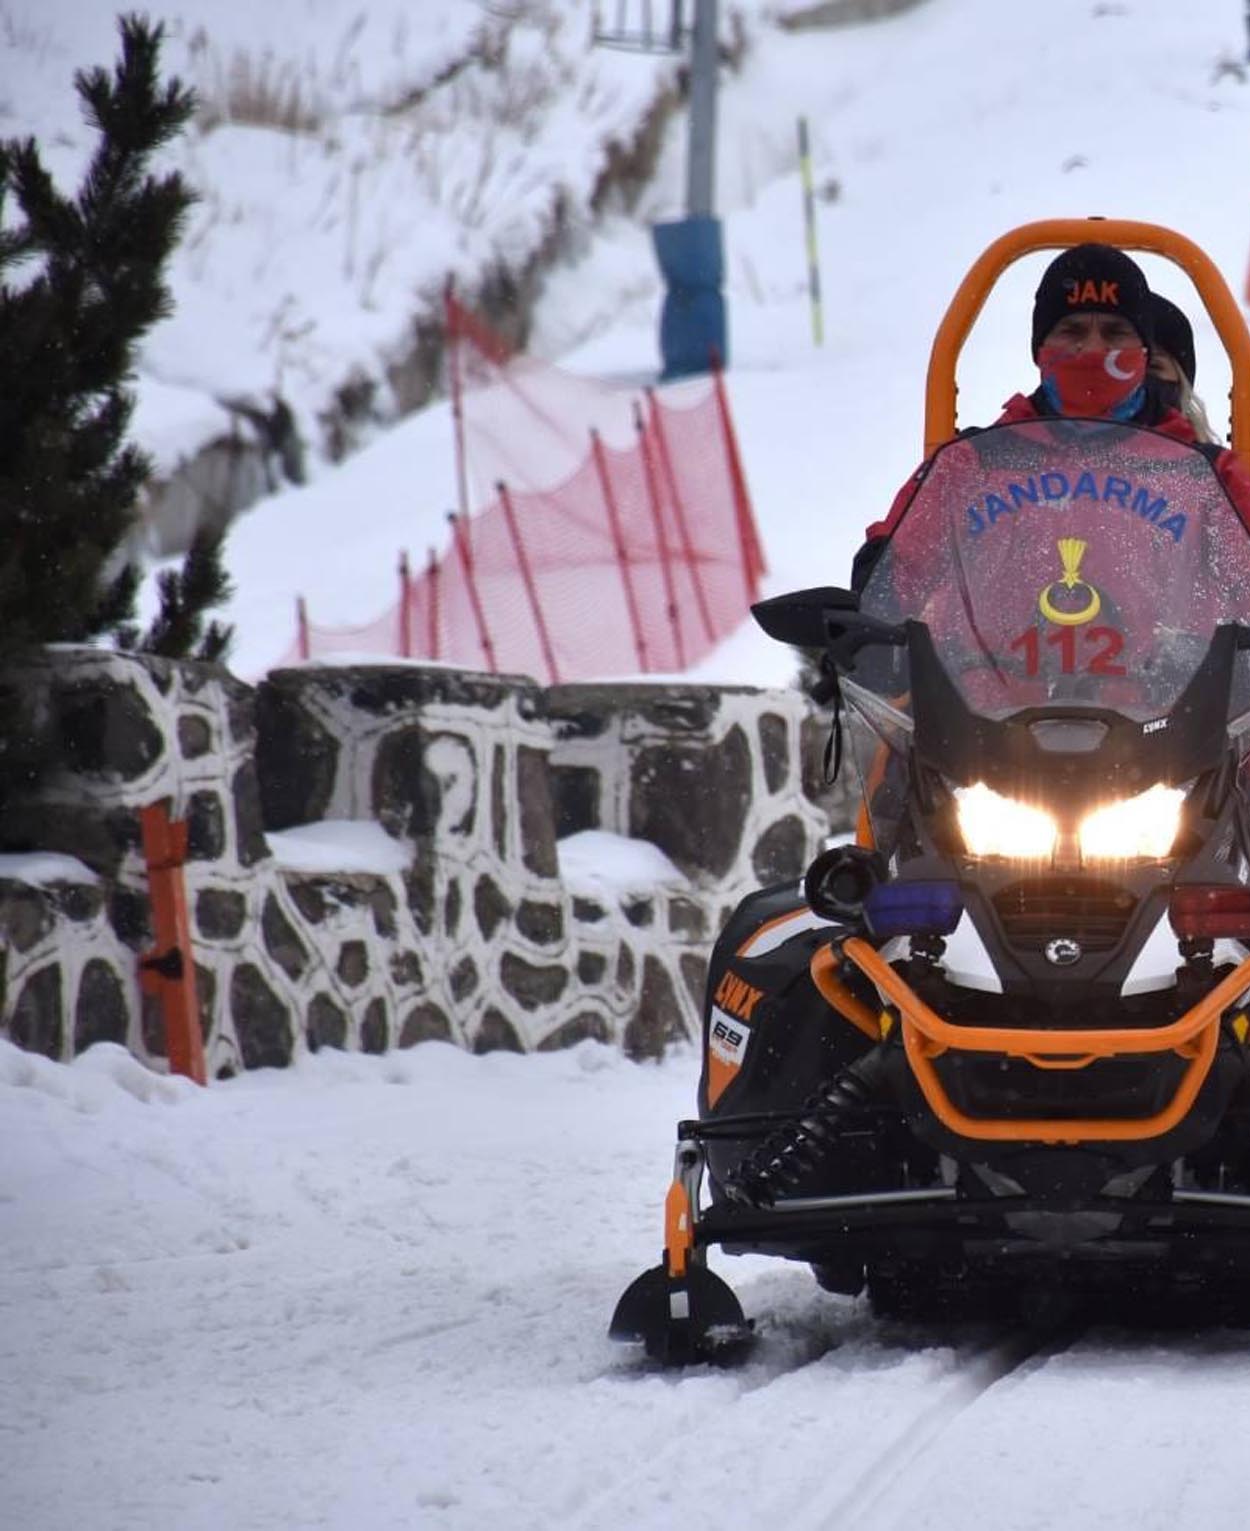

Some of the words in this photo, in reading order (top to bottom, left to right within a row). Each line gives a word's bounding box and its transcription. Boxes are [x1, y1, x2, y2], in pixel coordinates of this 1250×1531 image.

[1067, 280, 1119, 305] JAK
[967, 471, 1188, 543] JANDARMA
[1010, 624, 1127, 677] 112
[714, 970, 764, 1021] LYNX
[713, 1021, 743, 1047] 69
